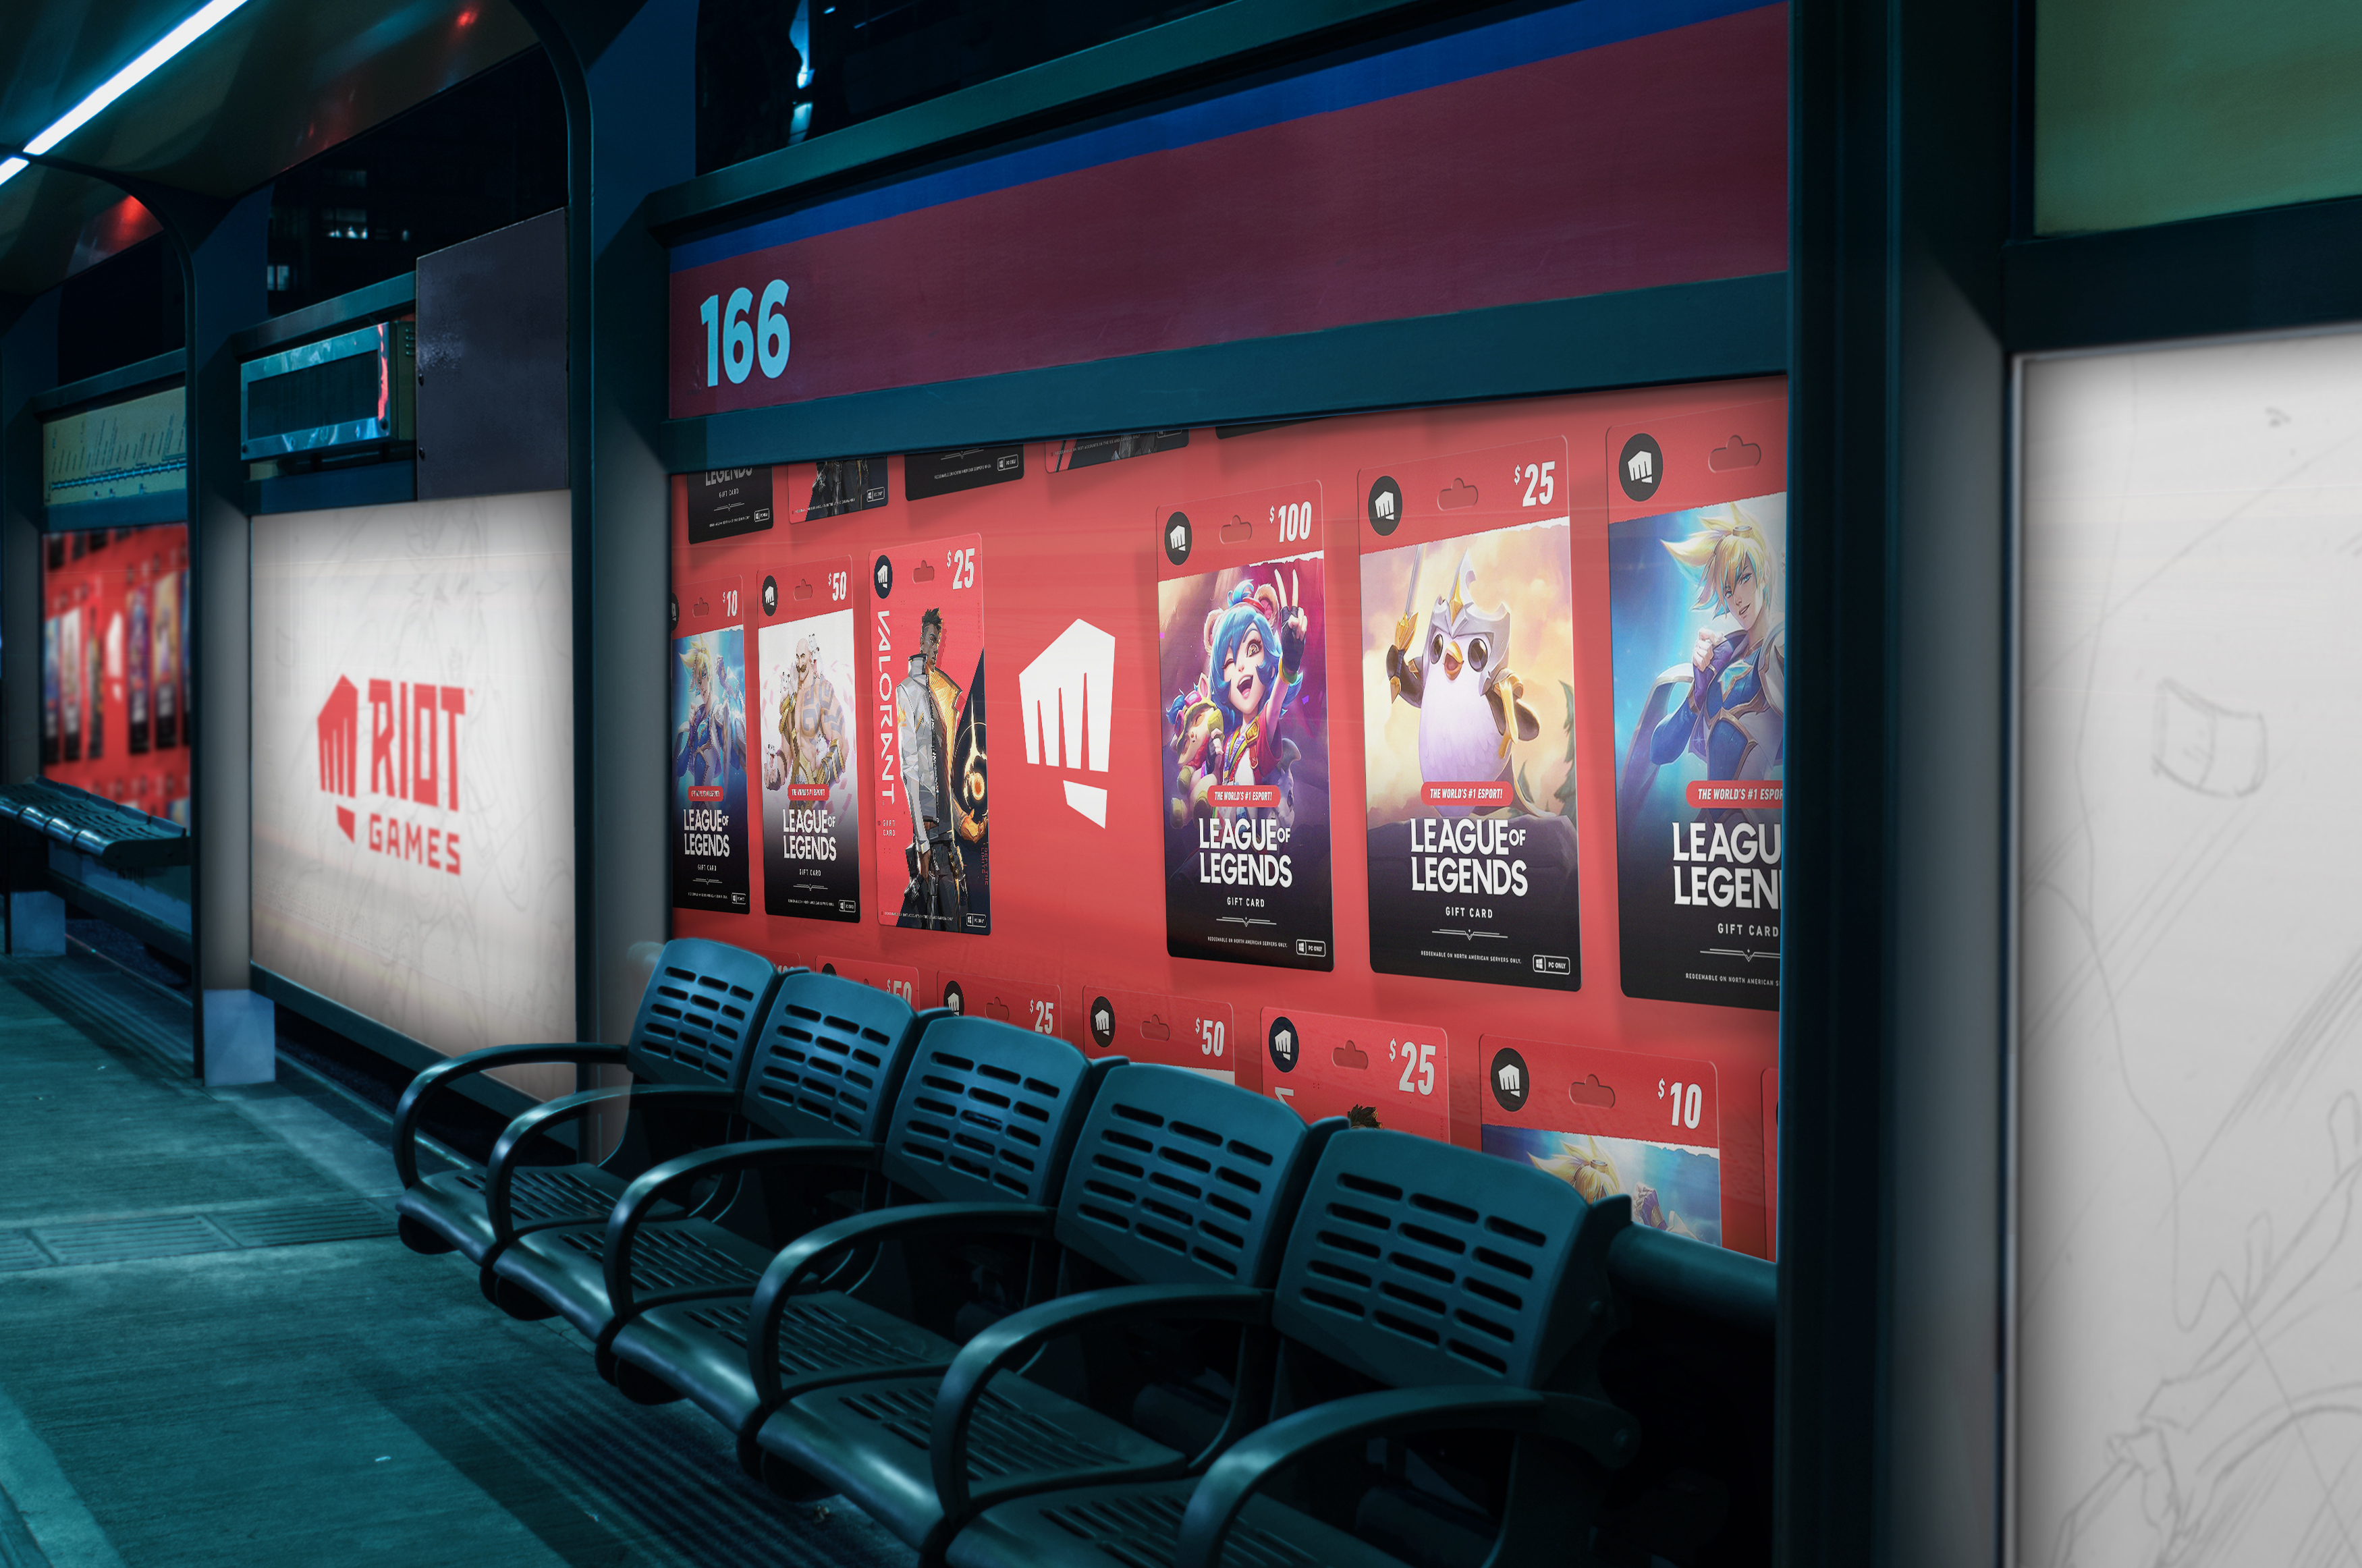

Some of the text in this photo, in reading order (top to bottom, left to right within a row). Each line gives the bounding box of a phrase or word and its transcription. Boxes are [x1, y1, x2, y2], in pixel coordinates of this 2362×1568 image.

[701, 279, 790, 387] 166
[1514, 460, 1556, 507] $25
[1269, 501, 1312, 542] $100
[828, 571, 847, 601] $50
[946, 547, 975, 590] $25
[722, 590, 738, 617] $10
[877, 610, 896, 805] VALORANT
[368, 677, 466, 812] RIOT
[1215, 791, 1273, 801] THE WORLD'S #1 ESPORT!
[1430, 788, 1503, 799] THE WORLD'S #1 ESPORT!
[1698, 788, 1711, 800] THE
[1713, 788, 1746, 800] WORLD'S
[1747, 788, 1758, 800] #1
[684, 809, 729, 832] LEAGUE OF
[783, 809, 836, 834] LEAGUE OF
[883, 819, 896, 827] GIFT
[1199, 817, 1290, 851] LEAGUE OF
[1410, 818, 1527, 856] LEAGUE OF
[369, 812, 461, 876] GAMES
[684, 833, 730, 858] LEGENDS
[783, 835, 837, 862] LEGENDS
[1672, 822, 1782, 864] LEAGU
[1199, 852, 1292, 888] LEGENDS
[1411, 856, 1529, 897] LEGENDS
[1673, 866, 1782, 909] LEGEN
[1227, 897, 1265, 907] GIFT CARD
[1445, 906, 1493, 919] GIFT CARD
[1718, 922, 1779, 937] GIFT CARD
[1421, 950, 1446, 958] REDEEMABLE
[1686, 972, 1718, 982] REDEEMABLE
[1030, 998, 1054, 1034] $25
[1195, 1017, 1225, 1057] $50
[1389, 1038, 1436, 1096] $25
[1657, 1077, 1702, 1129] $10
